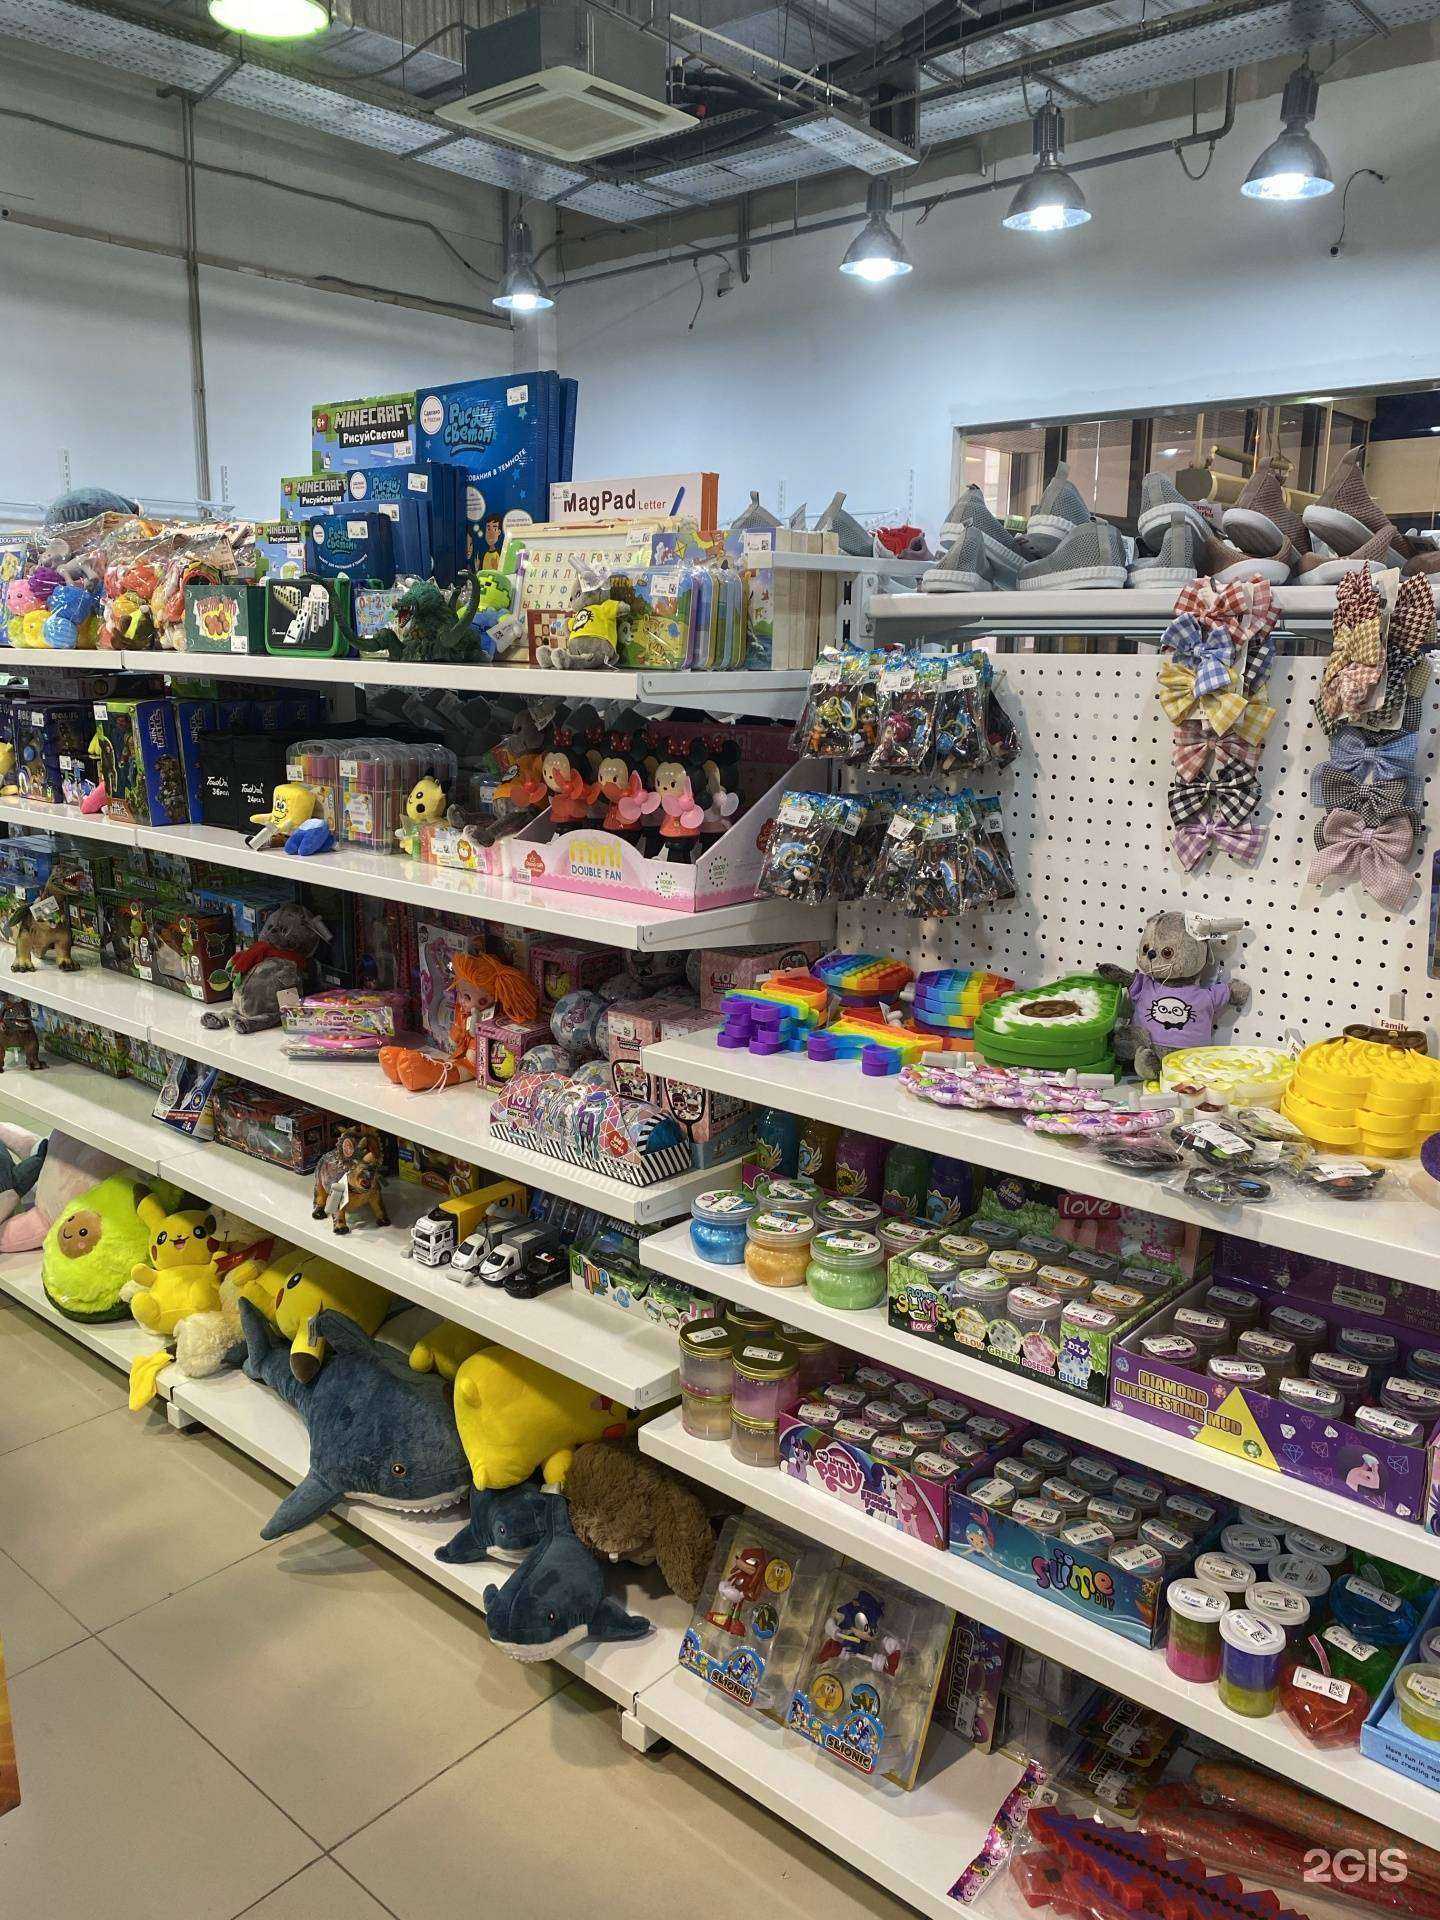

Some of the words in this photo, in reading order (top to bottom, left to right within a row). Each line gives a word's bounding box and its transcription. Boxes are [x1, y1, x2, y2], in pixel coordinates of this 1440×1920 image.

[333, 403, 412, 429] MINECRAFT
[342, 429, 405, 444] РисуйСветом
[297, 480, 349, 494] MINECRAFT
[563, 489, 636, 516] MagPad
[638, 500, 667, 510] Letter
[571, 865, 602, 878] DOUBLE
[605, 869, 622, 881] FAN
[1381, 1020, 1408, 1031] Family
[1063, 1196, 1112, 1216] love
[987, 1345, 1020, 1365] GREEN
[1021, 1358, 1055, 1376] ROSERED
[1059, 1371, 1089, 1390] BLUE
[1139, 1371, 1207, 1407] DIAMOND
[1115, 1378, 1206, 1425] INTERESTING
[1206, 1410, 1242, 1436] MUD
